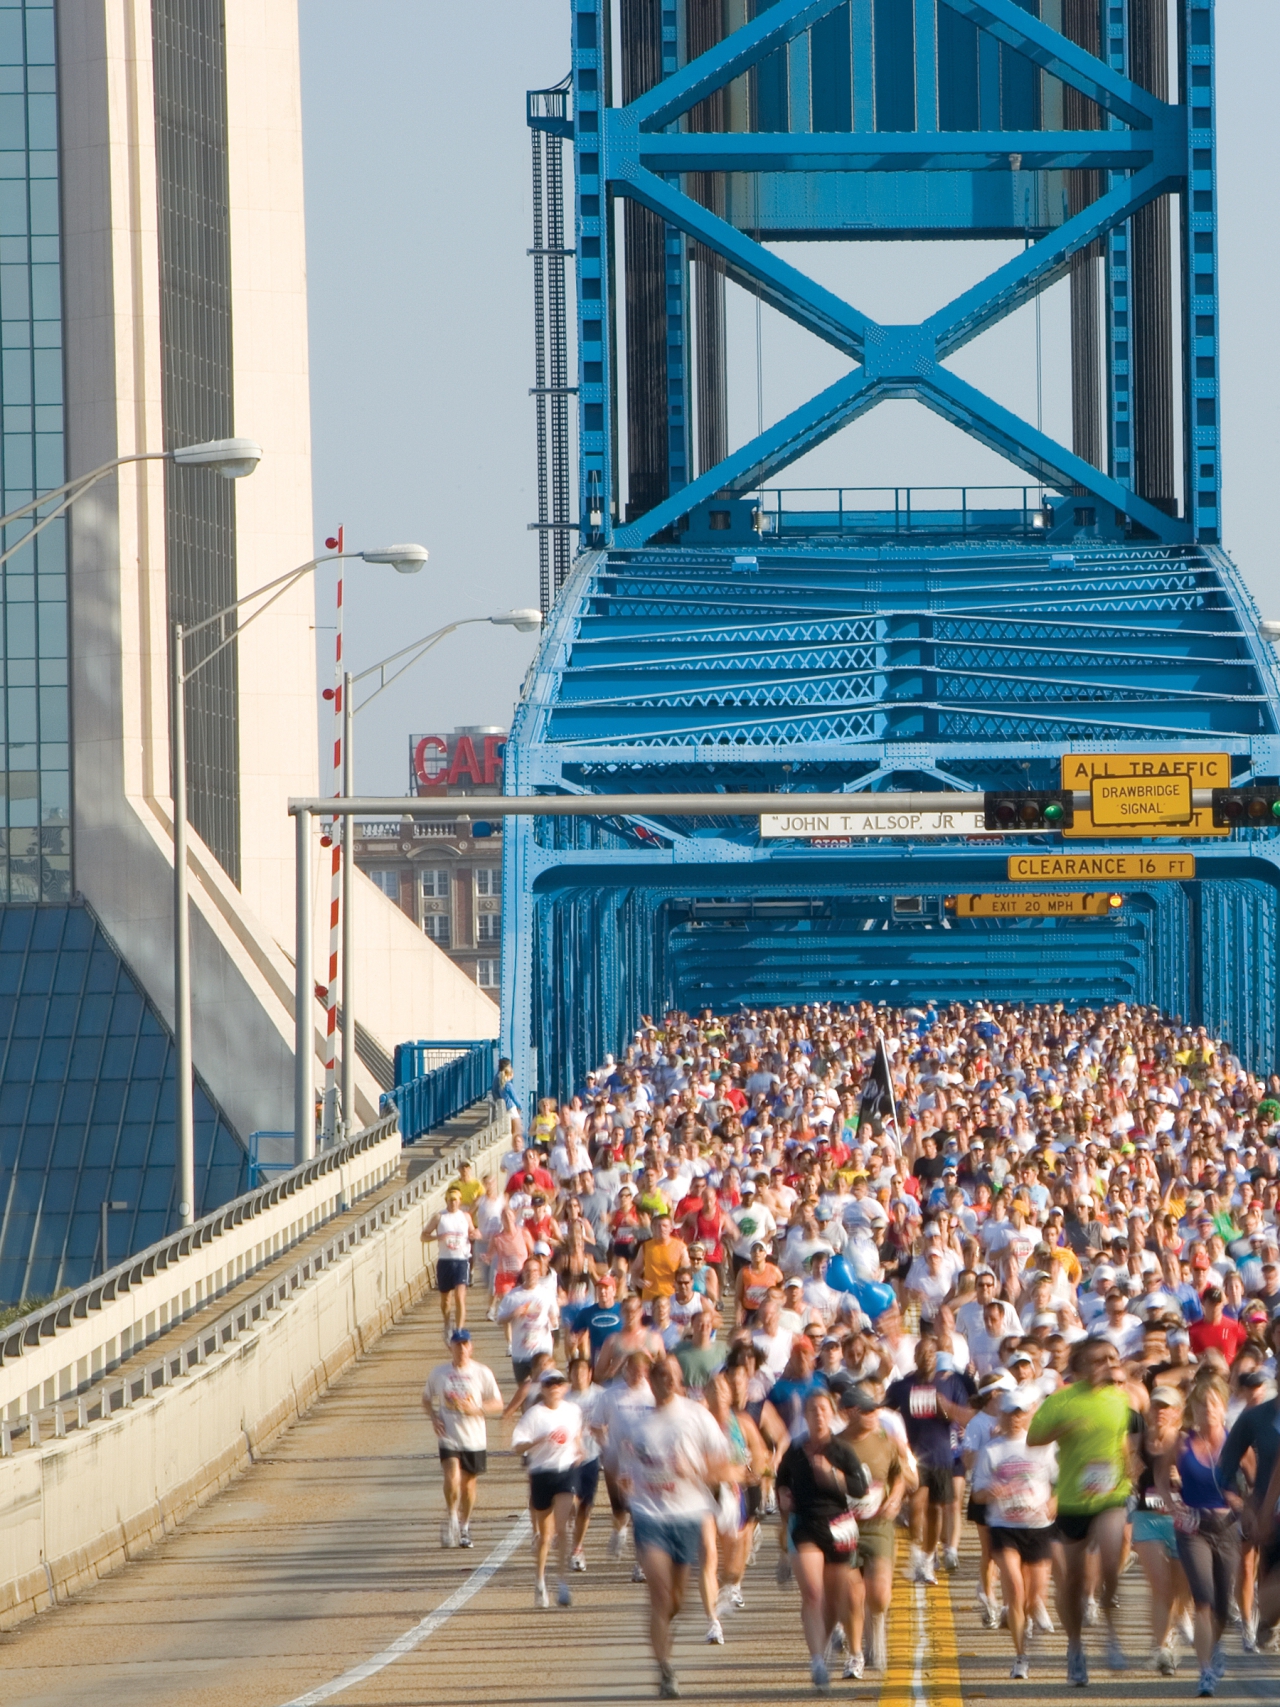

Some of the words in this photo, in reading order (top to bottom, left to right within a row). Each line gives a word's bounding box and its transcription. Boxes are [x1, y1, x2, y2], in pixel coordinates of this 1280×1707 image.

[1075, 762, 1115, 777] ALL
[1129, 761, 1218, 776] TRAFFIC
[1102, 784, 1180, 798] DRAWBRIDGE
[1120, 803, 1164, 815] SIGNAL
[840, 816, 852, 831] T.
[932, 814, 954, 829] JR
[1018, 858, 1126, 875] CLEARANCE
[1139, 858, 1156, 873] 16
[1169, 860, 1185, 873] FT
[992, 901, 1017, 912] EXIT
[1025, 901, 1040, 911] 20
[1048, 901, 1073, 911] MPH
